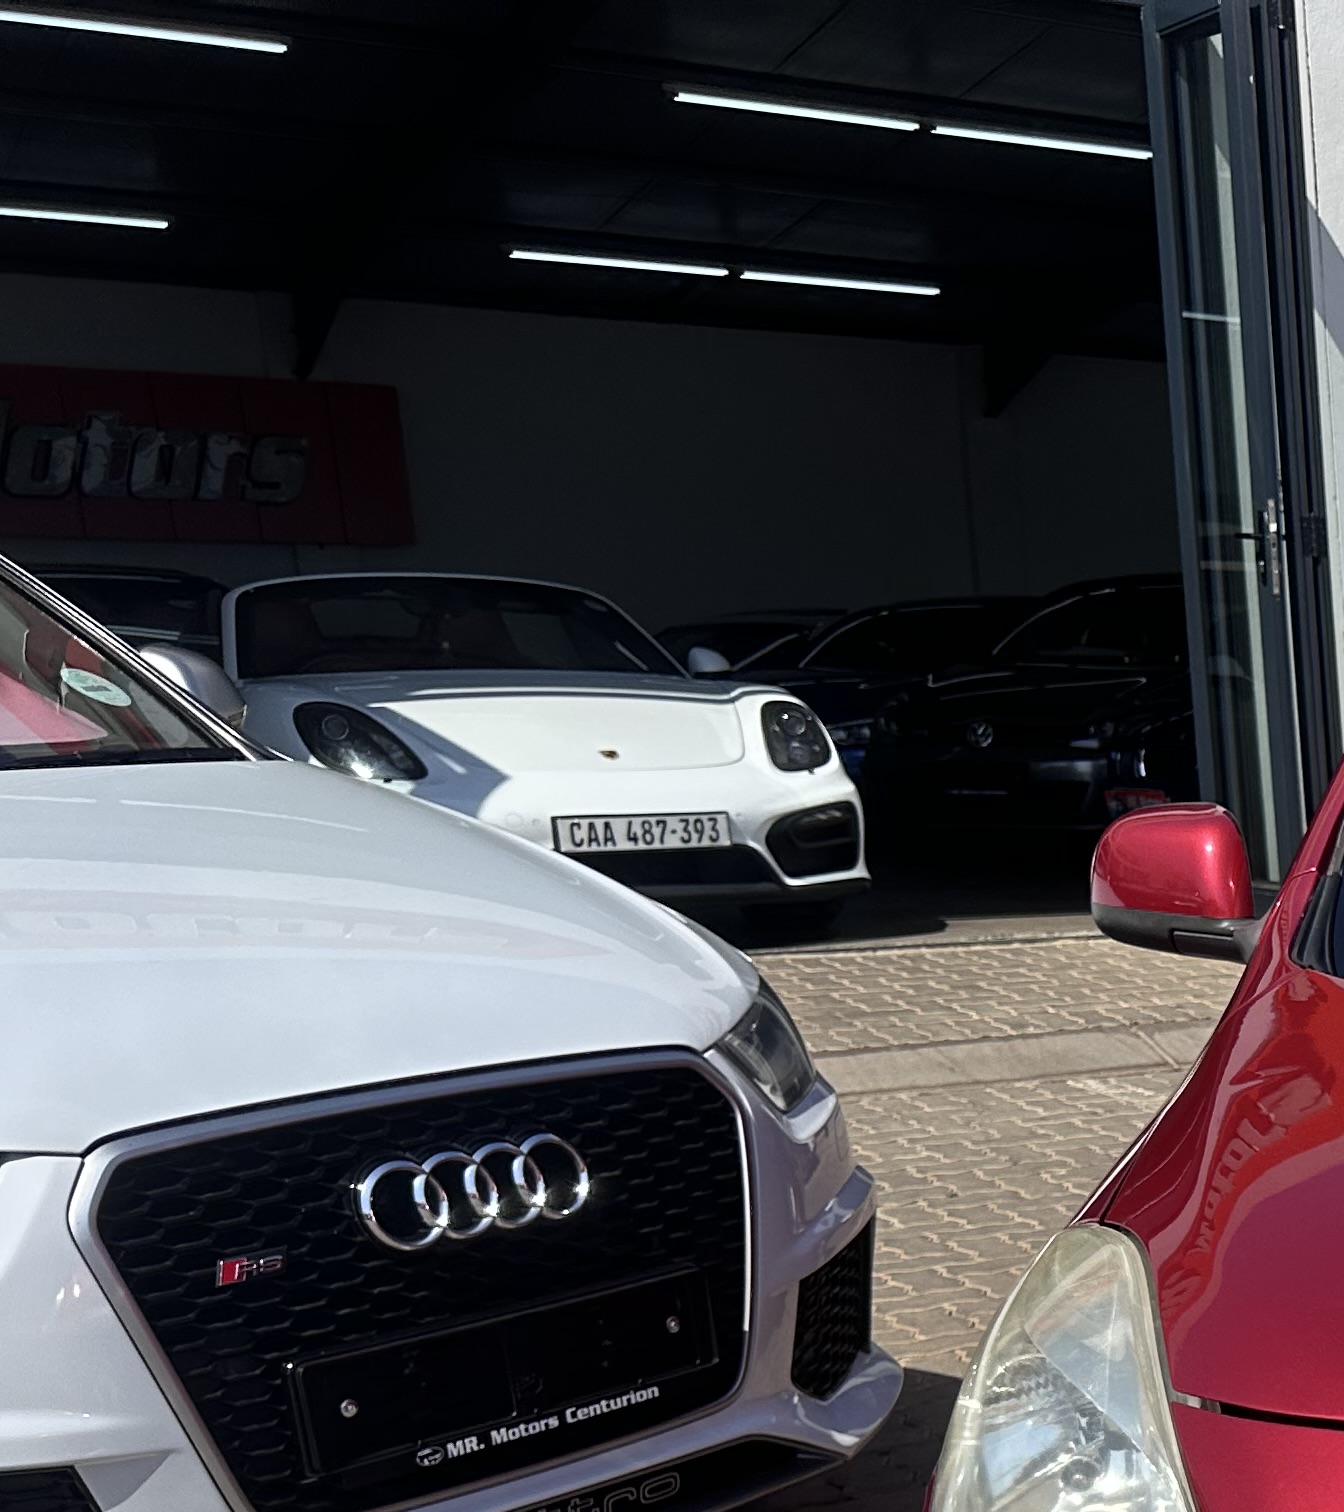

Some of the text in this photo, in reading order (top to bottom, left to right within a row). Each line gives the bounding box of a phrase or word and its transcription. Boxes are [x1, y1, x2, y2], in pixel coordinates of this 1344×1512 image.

[0, 402, 314, 505] otors
[570, 817, 721, 849] CAA 487-393
[446, 1385, 660, 1459] MR. Motors Centurion
